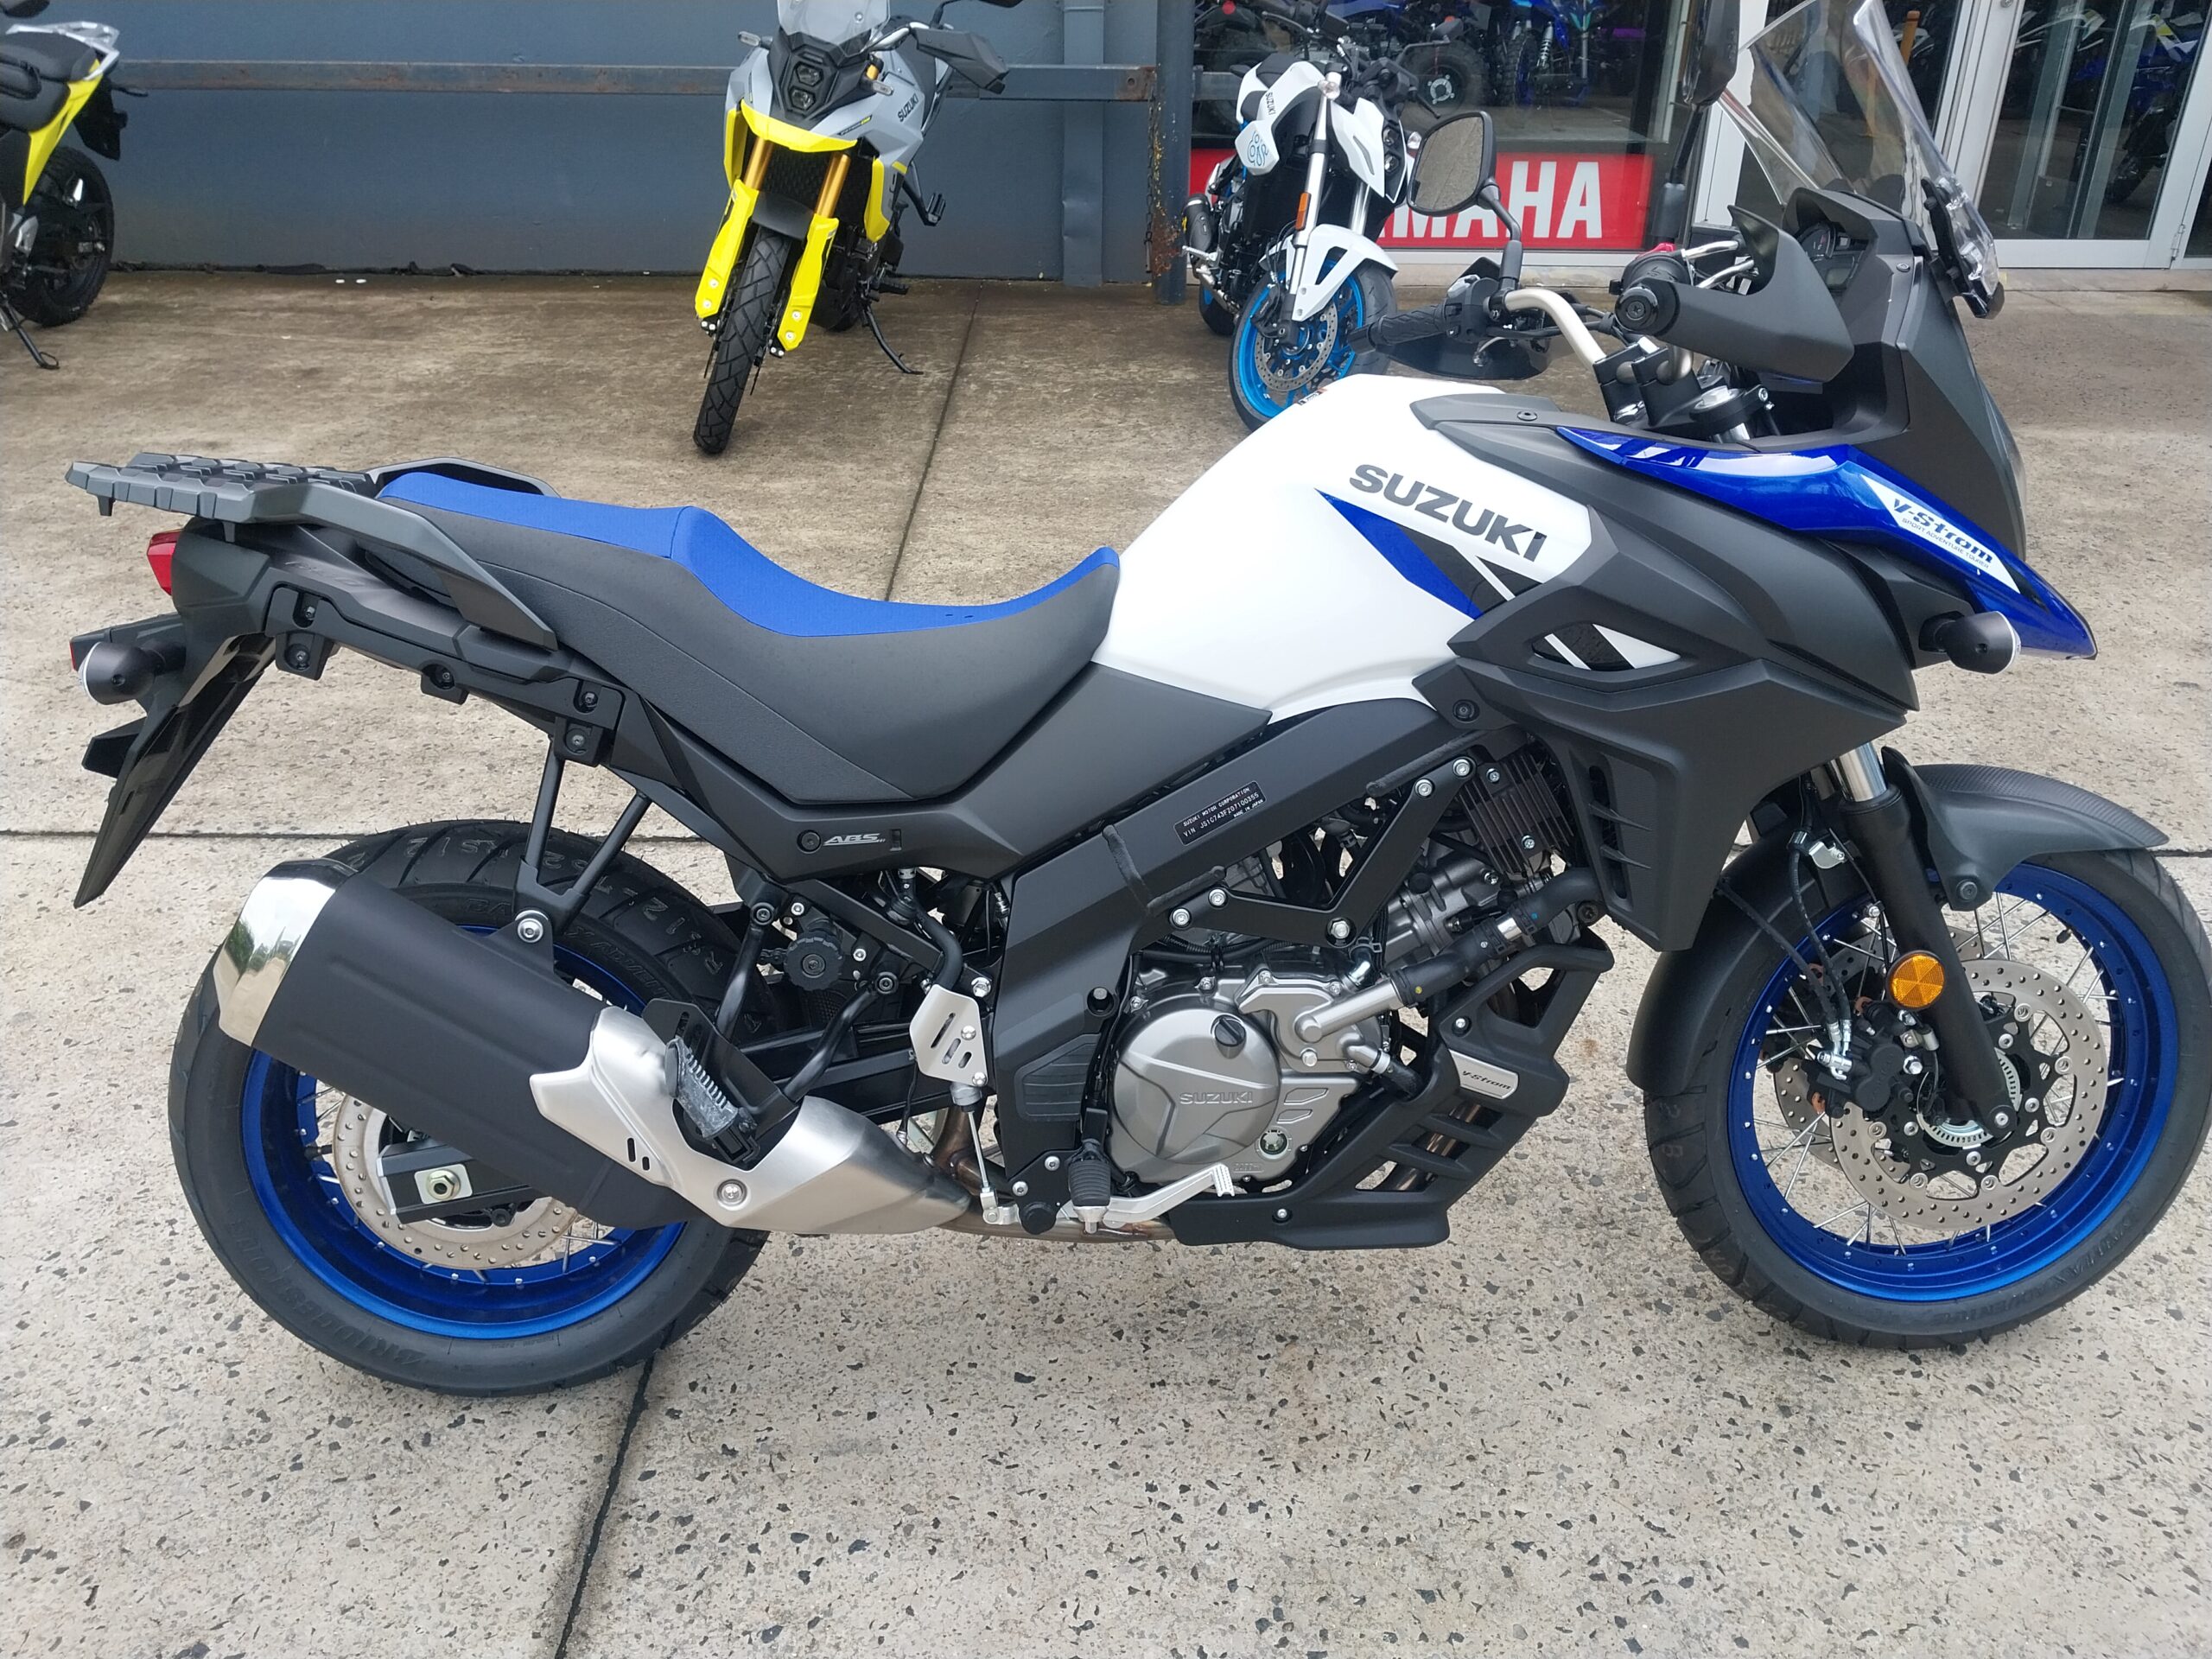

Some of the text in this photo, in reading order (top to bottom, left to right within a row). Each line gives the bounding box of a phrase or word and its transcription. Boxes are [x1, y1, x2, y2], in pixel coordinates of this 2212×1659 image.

[898, 92, 919, 122] SUZUKI
[1266, 92, 1276, 115] SUZUKI
[1350, 464, 1548, 563] SUZUKI
[1902, 518, 1989, 569] SPORT ADVENTURE TOURER
[1183, 787, 1250, 827] SUZUKI MOTOR CORPORATION
[823, 832, 880, 846] ABS
[1183, 827, 1197, 837] VIN
[1179, 1091, 1253, 1105] SUZUKI
